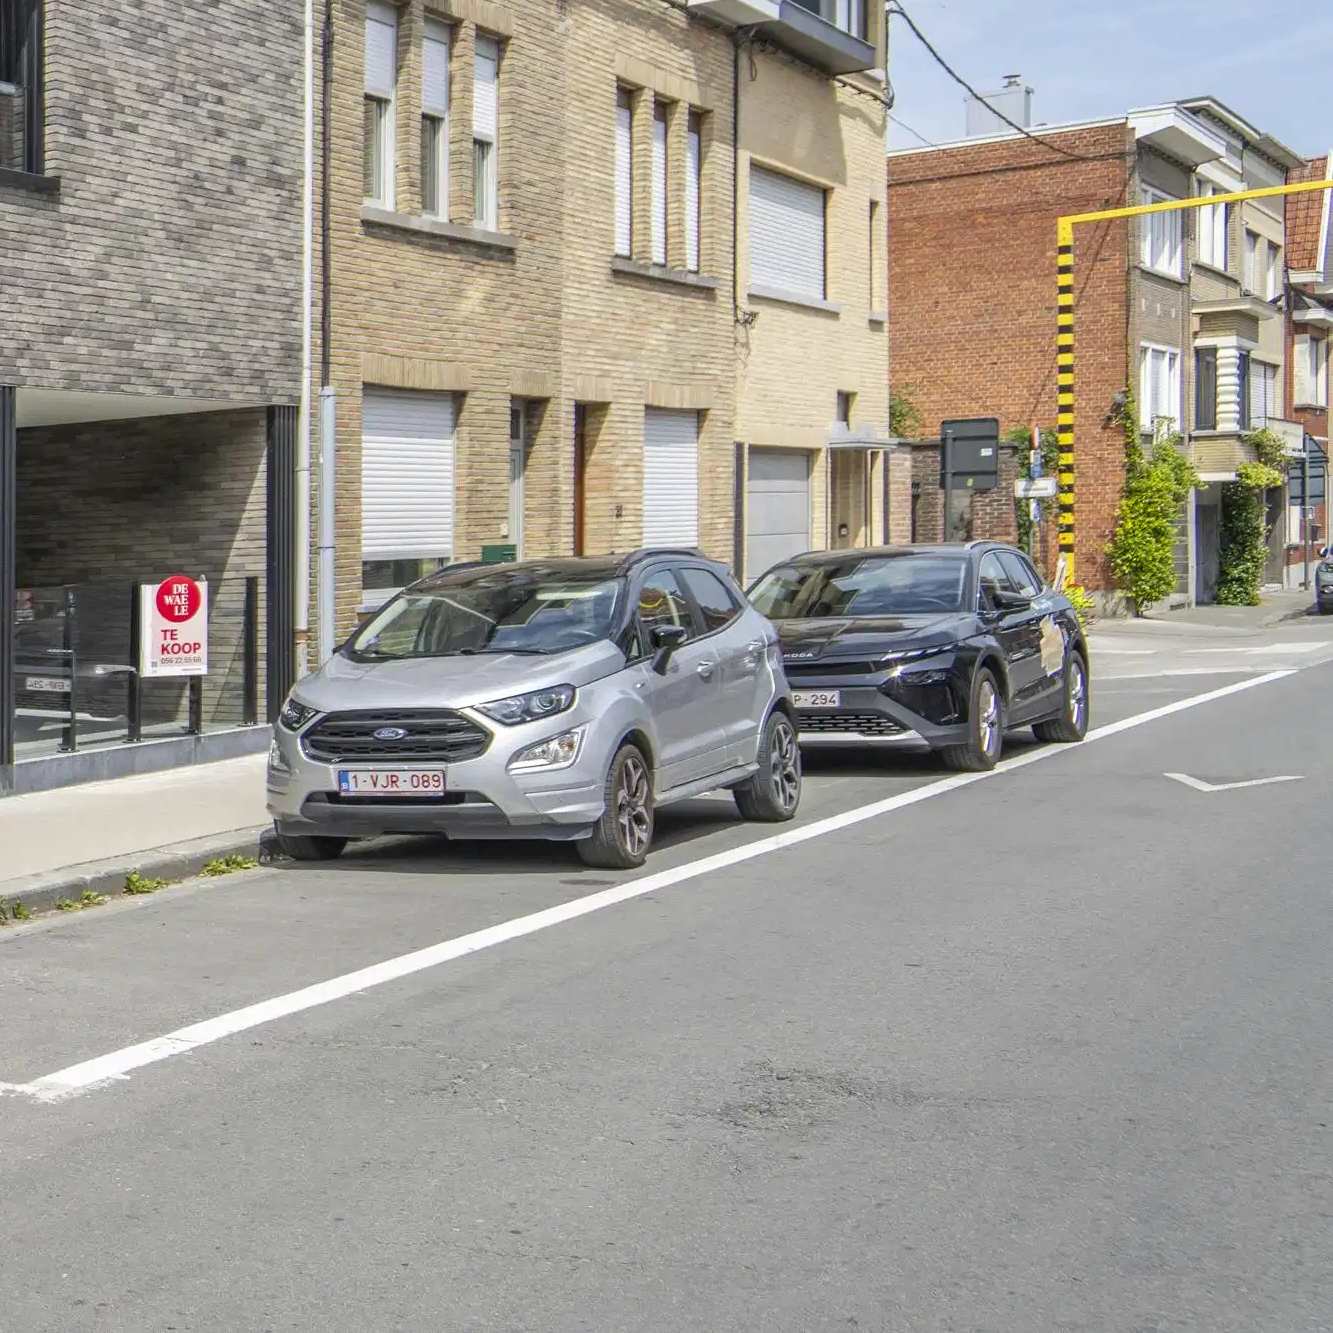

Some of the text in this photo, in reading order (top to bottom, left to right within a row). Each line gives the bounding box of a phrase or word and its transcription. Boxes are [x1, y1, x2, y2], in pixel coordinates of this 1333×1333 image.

[173, 583, 188, 594] DE
[164, 594, 189, 605] WAE
[174, 605, 188, 616] LE
[161, 629, 178, 640] TE
[161, 642, 201, 655] KOOP
[793, 693, 837, 706] P-294
[352, 774, 441, 789] 1-VJR-089
